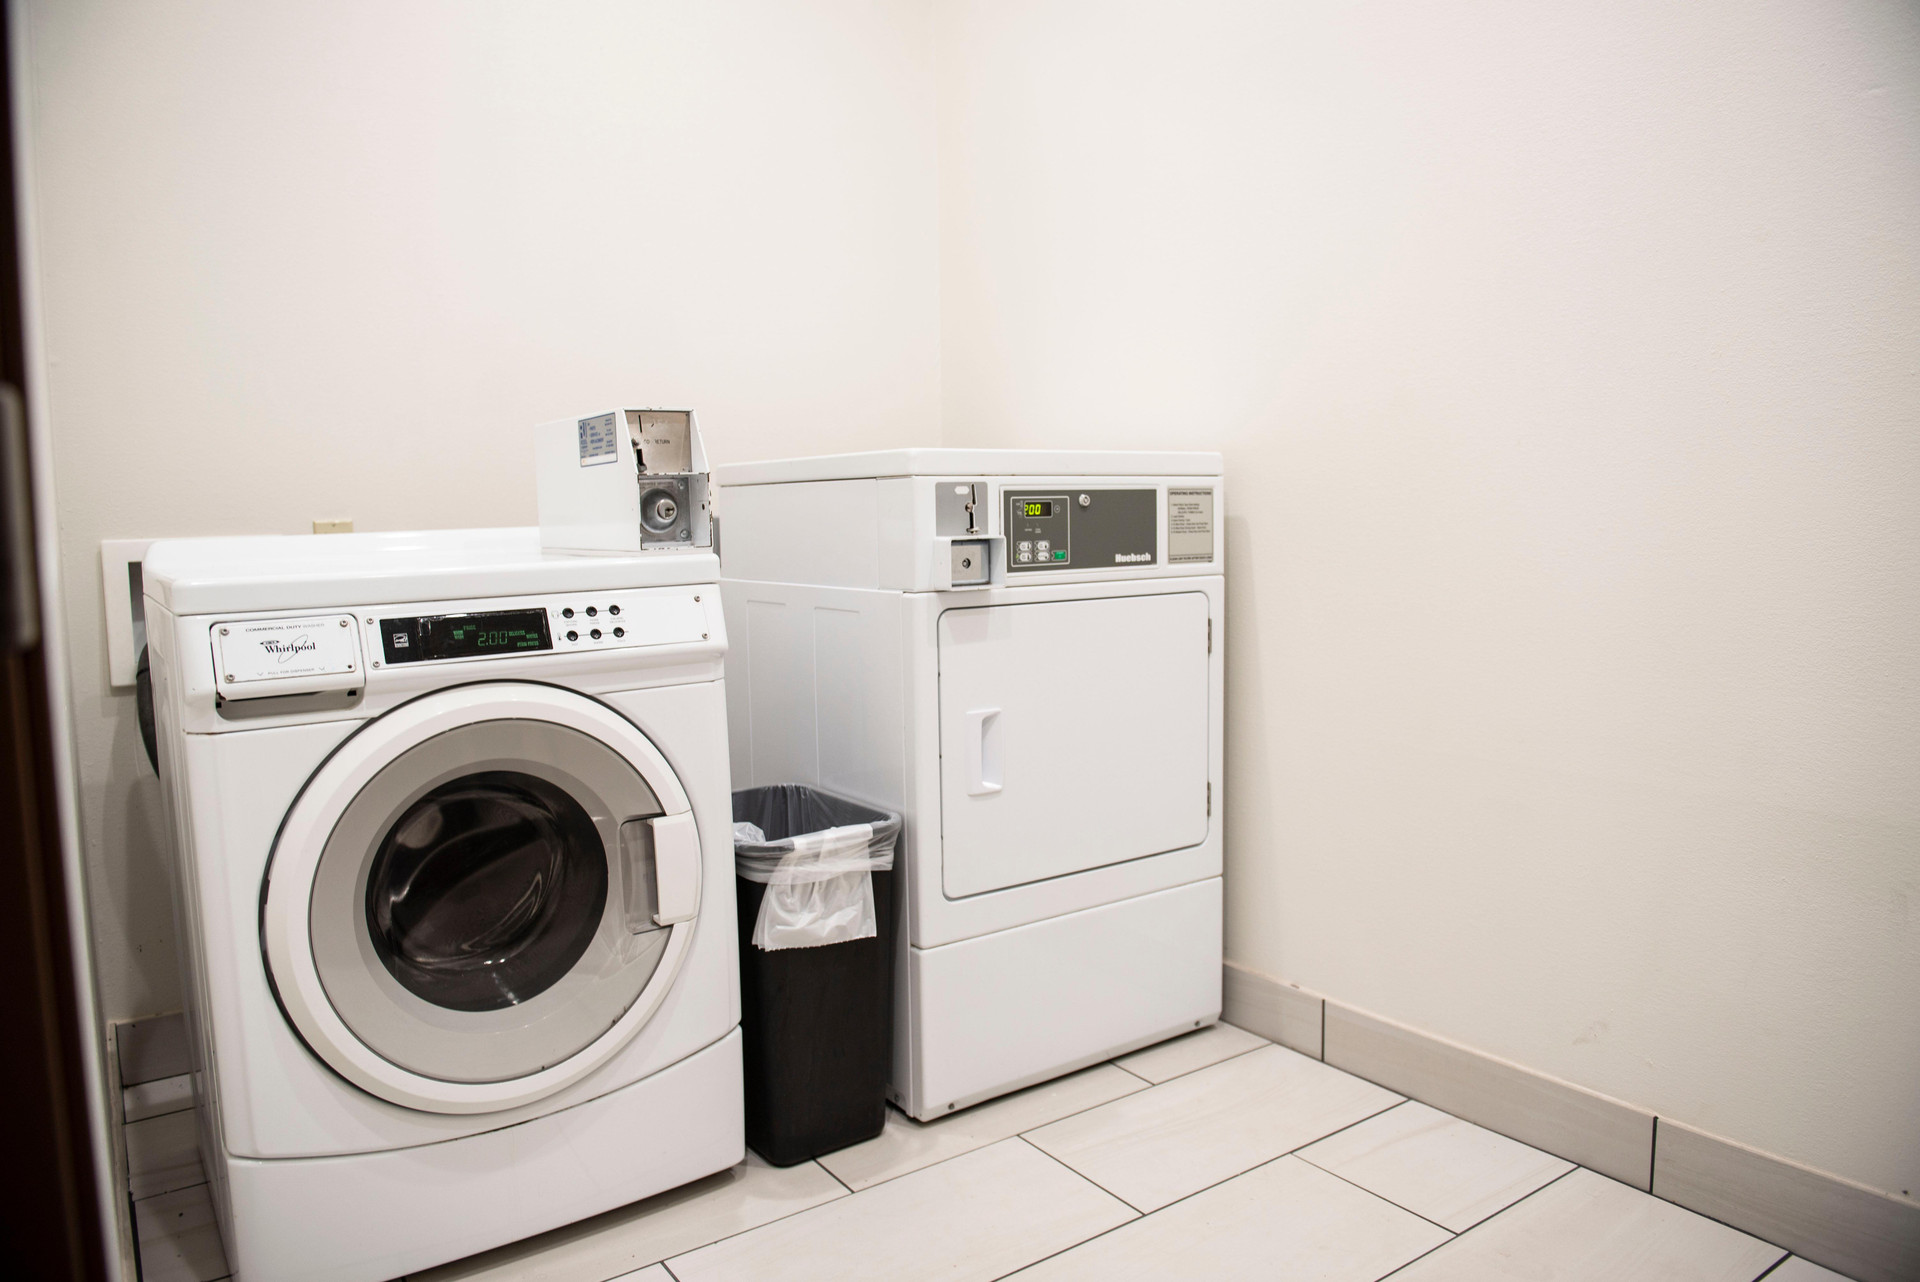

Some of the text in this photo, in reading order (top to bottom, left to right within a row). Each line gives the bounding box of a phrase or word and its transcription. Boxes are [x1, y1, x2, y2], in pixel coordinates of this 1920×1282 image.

[1115, 552, 1151, 563] Huebsch
[477, 630, 508, 647] 2.00
[264, 641, 316, 654] Whirlpool
